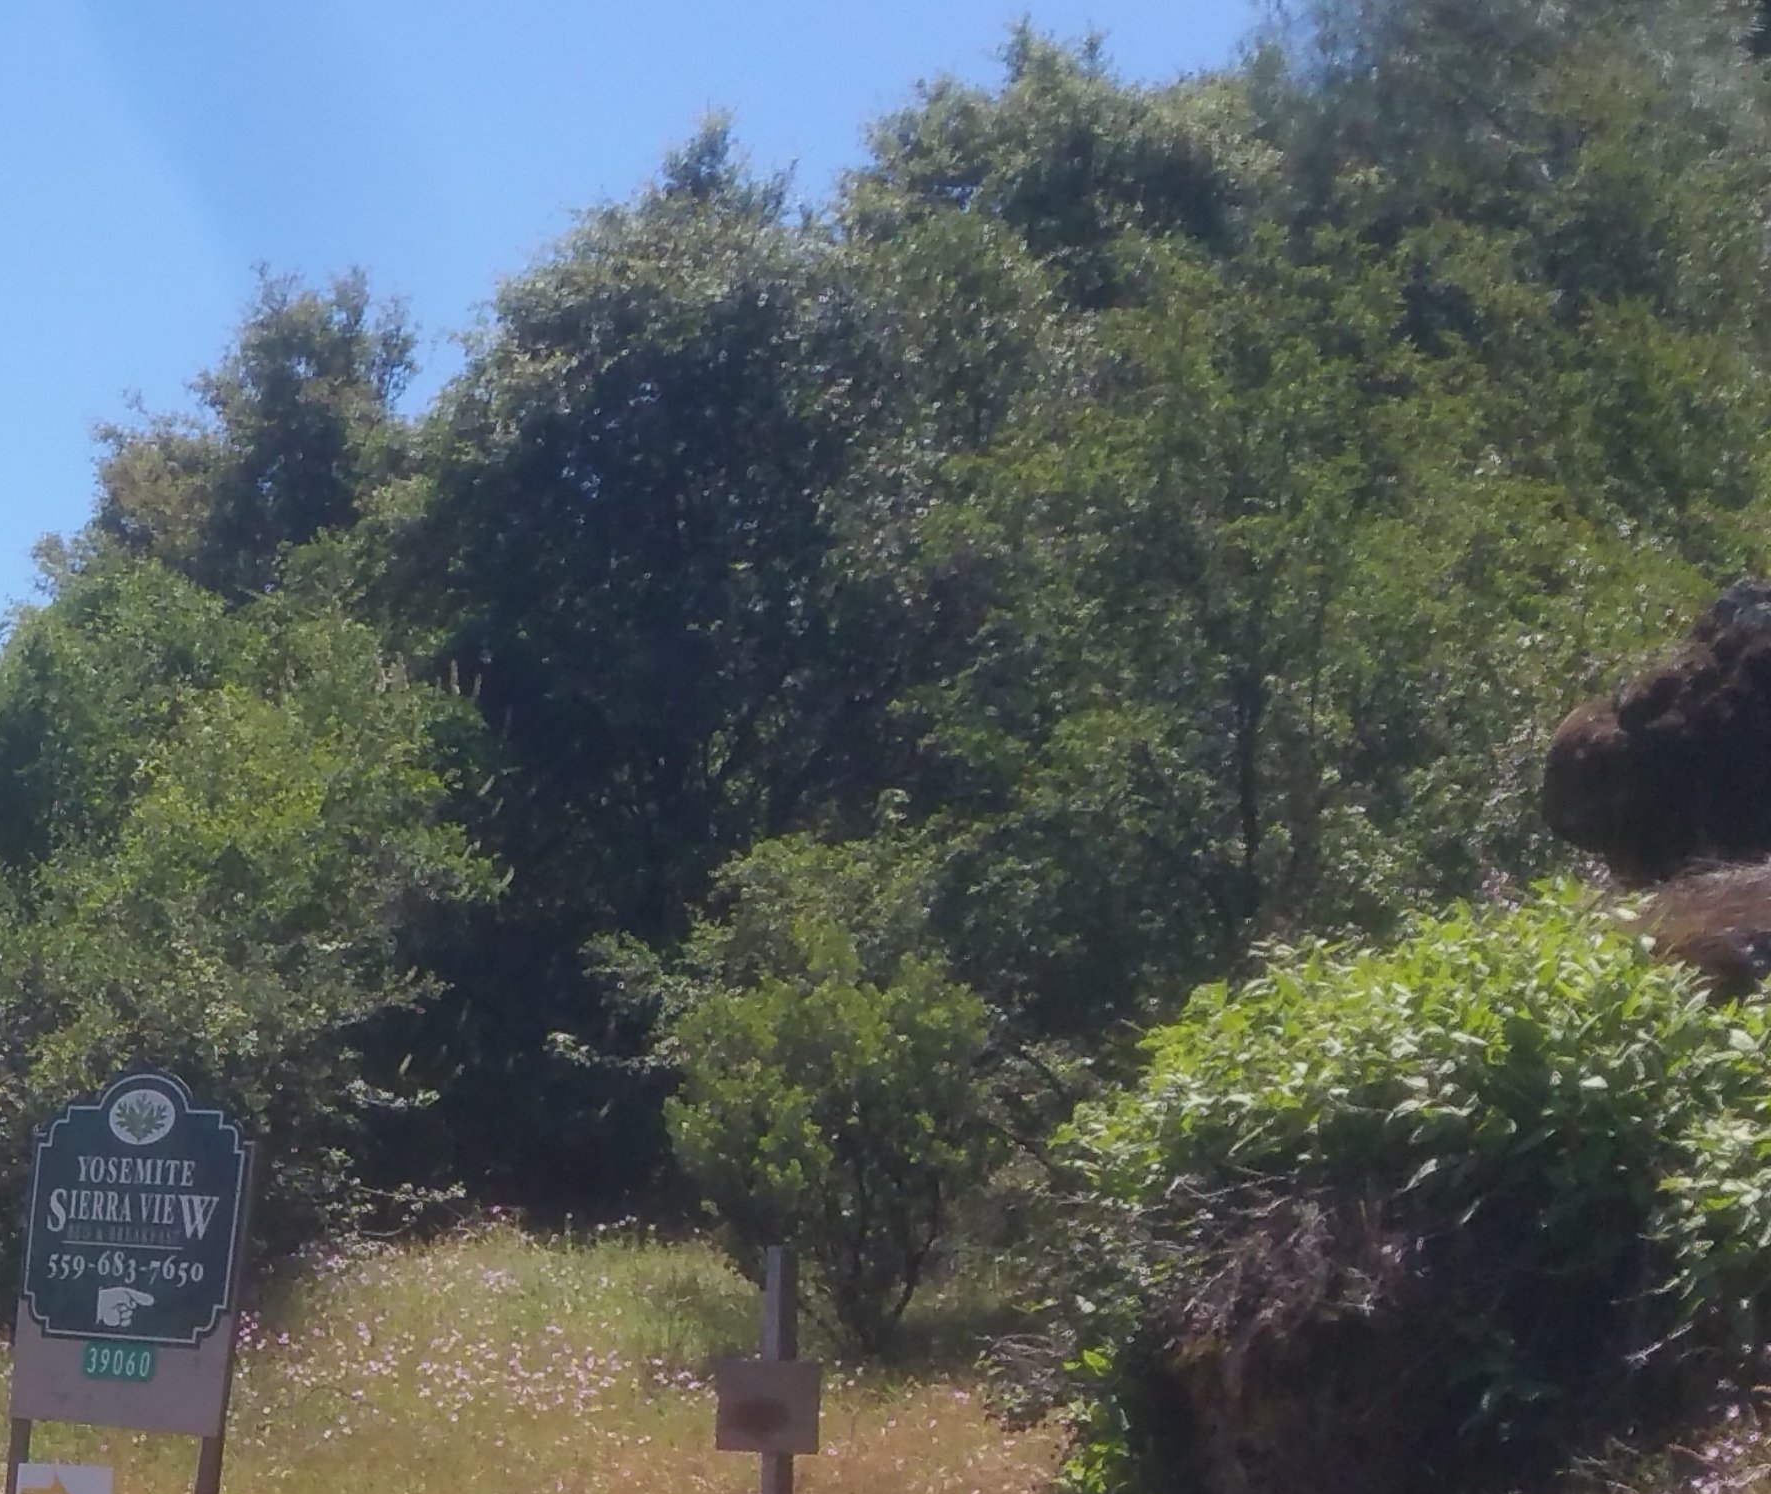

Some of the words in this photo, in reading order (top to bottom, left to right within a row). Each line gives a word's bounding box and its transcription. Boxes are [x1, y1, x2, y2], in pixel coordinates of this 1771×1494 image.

[77, 1155, 196, 1187] YOSEMITE
[46, 1188, 132, 1232] SIERRA
[139, 1192, 220, 1241] VIEW
[46, 1250, 205, 1289] 559-683-7650
[86, 1346, 151, 1377] 39060
